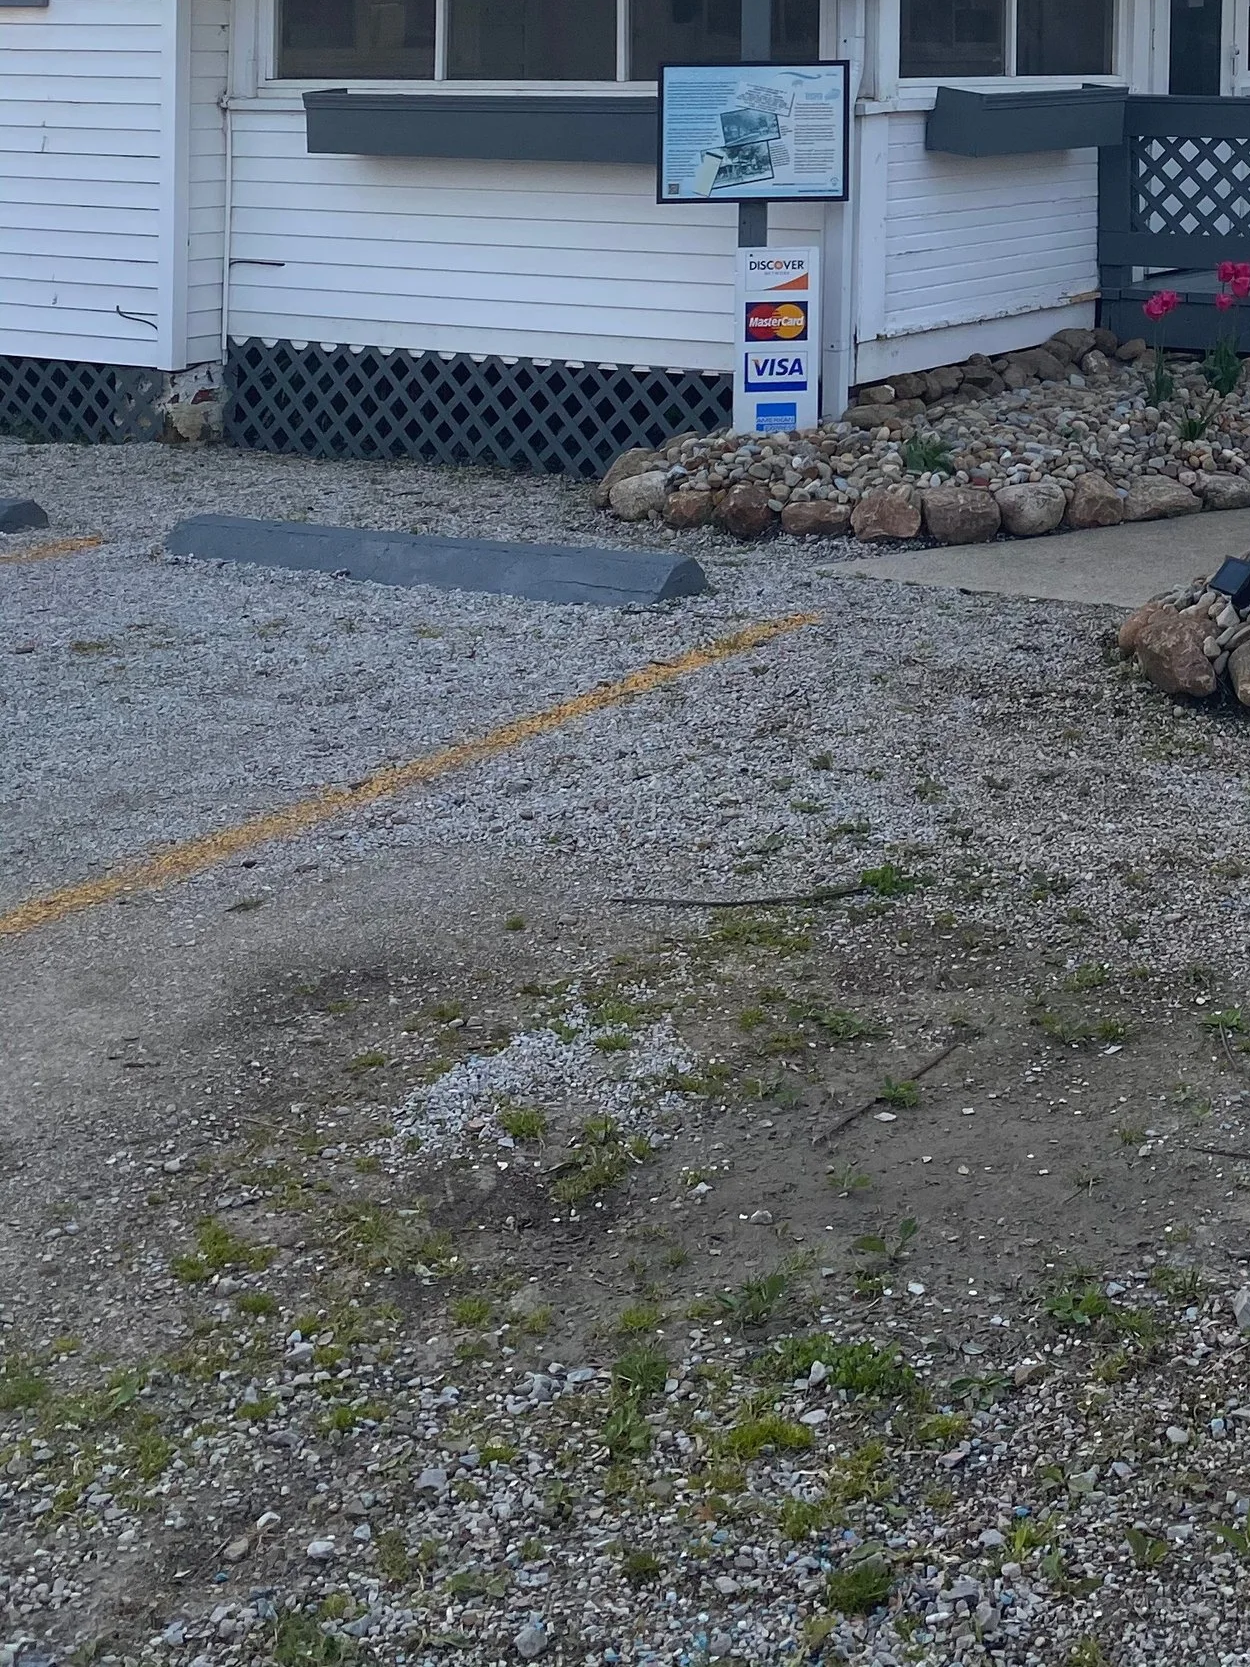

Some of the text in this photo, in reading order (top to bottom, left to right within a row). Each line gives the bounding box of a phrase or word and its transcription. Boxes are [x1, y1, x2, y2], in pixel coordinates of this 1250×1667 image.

[749, 260, 804, 270] DISCOVER
[749, 315, 805, 328] MasterCard
[751, 358, 804, 377] VISA
